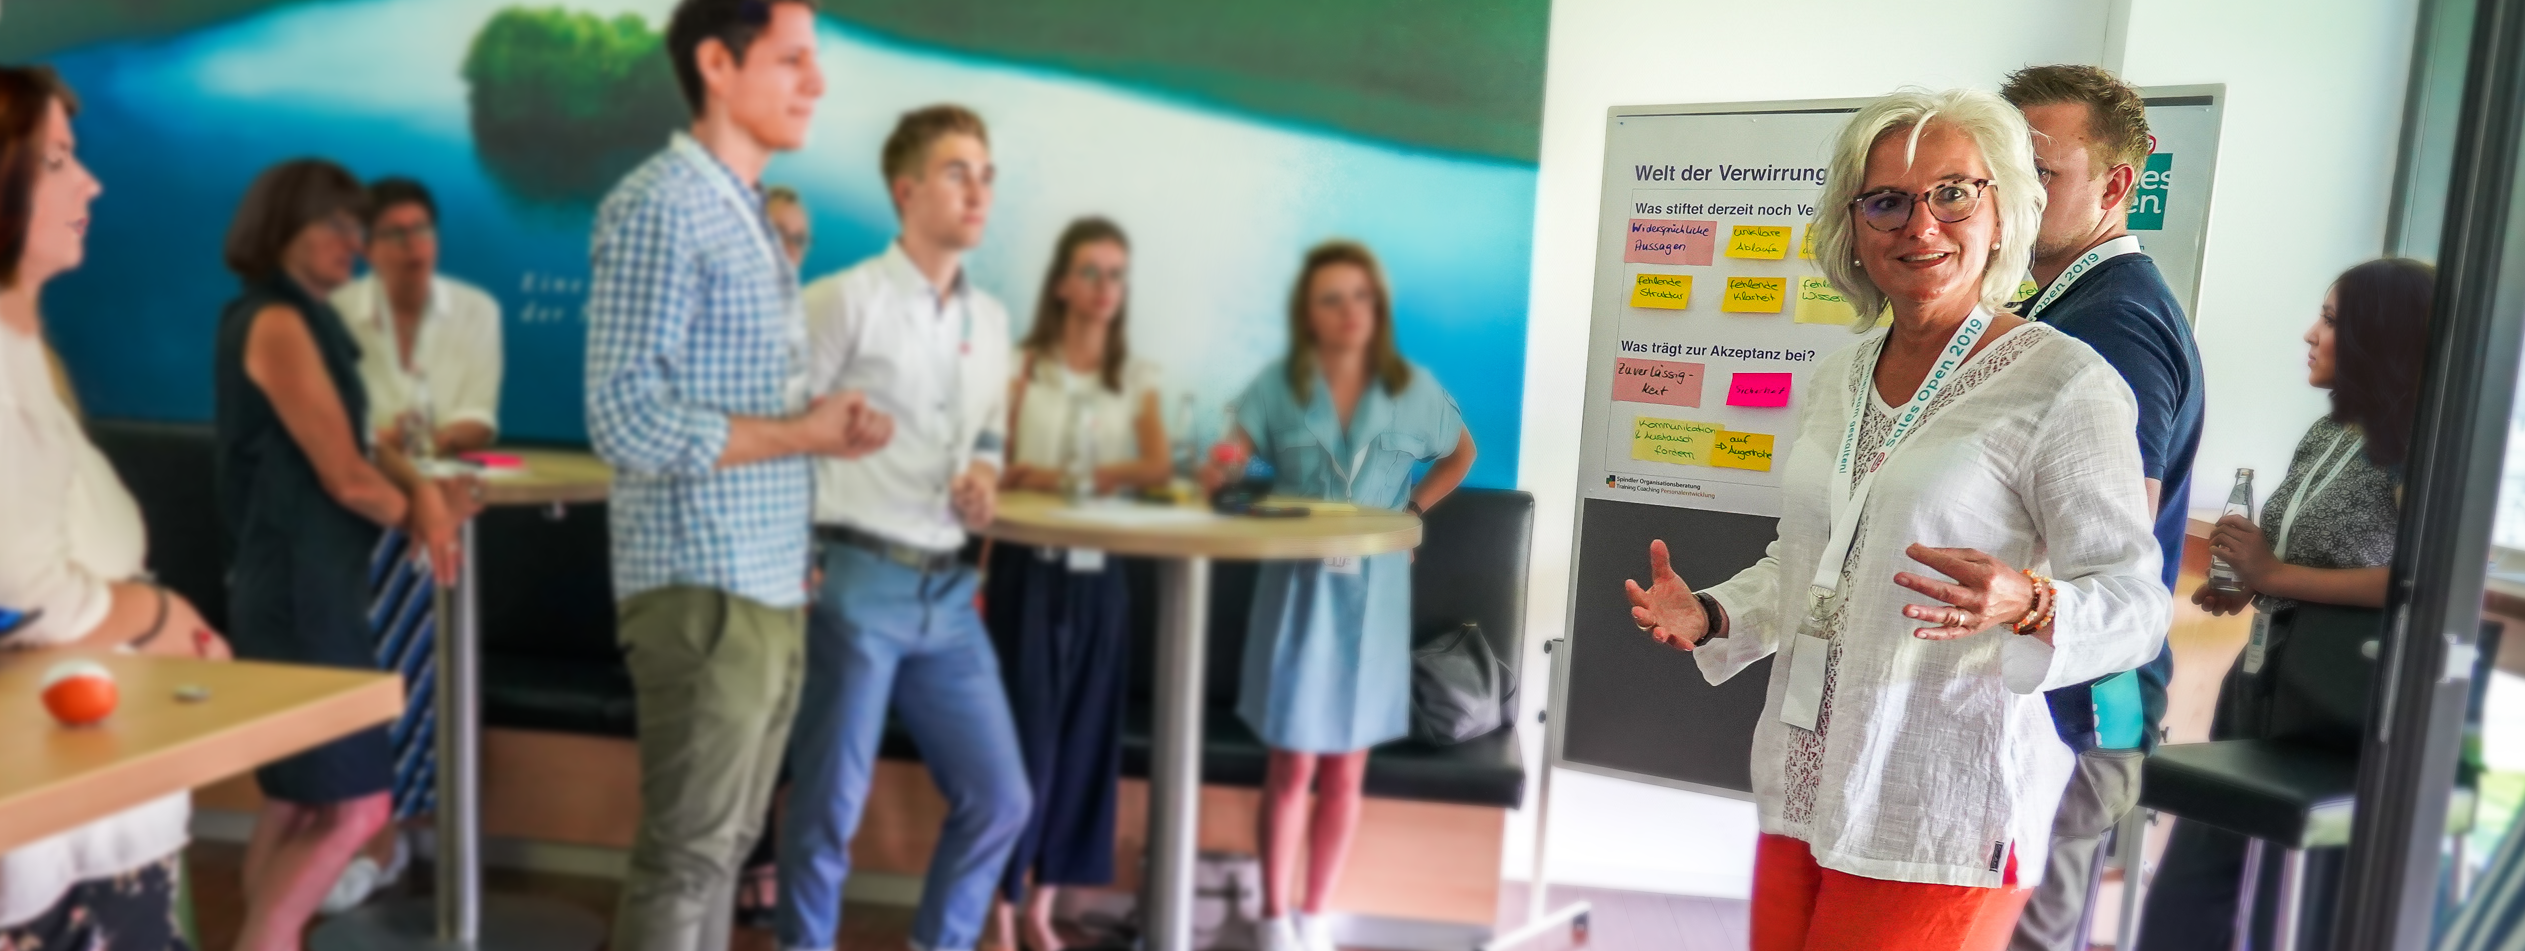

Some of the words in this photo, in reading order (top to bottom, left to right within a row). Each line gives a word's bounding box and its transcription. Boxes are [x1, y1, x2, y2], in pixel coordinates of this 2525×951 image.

[1635, 164, 1676, 182] Welt
[1681, 164, 1713, 182] der
[1719, 164, 1828, 186] Verwirrung
[1635, 202, 1662, 215] Was
[1666, 202, 1704, 215] stiftet
[1707, 203, 1754, 216] derzeit
[1758, 204, 1792, 216] noch
[1635, 239, 1686, 255] Aussagen
[1637, 276, 1682, 288] fehlende
[1730, 279, 1779, 291] fehlende
[2034, 282, 2066, 315] Open
[2064, 253, 2099, 282] 2019
[1621, 340, 1648, 353] Was
[1652, 342, 1682, 357] trägt
[1686, 345, 1707, 356] zur
[1710, 345, 1781, 361] Akzeptanz
[1785, 349, 1816, 362] bei?
[1885, 405, 1920, 447] Sales
[1917, 360, 1955, 402] Open
[1949, 318, 1983, 357] 2019
[1729, 434, 1751, 445] auf
[1616, 476, 1639, 485] Spindler
[1639, 478, 1701, 491] Organisationsberatung
[1616, 484, 1636, 492] Training
[1637, 485, 1660, 494] Coaching
[1661, 488, 1716, 499] Personalentwicklung
